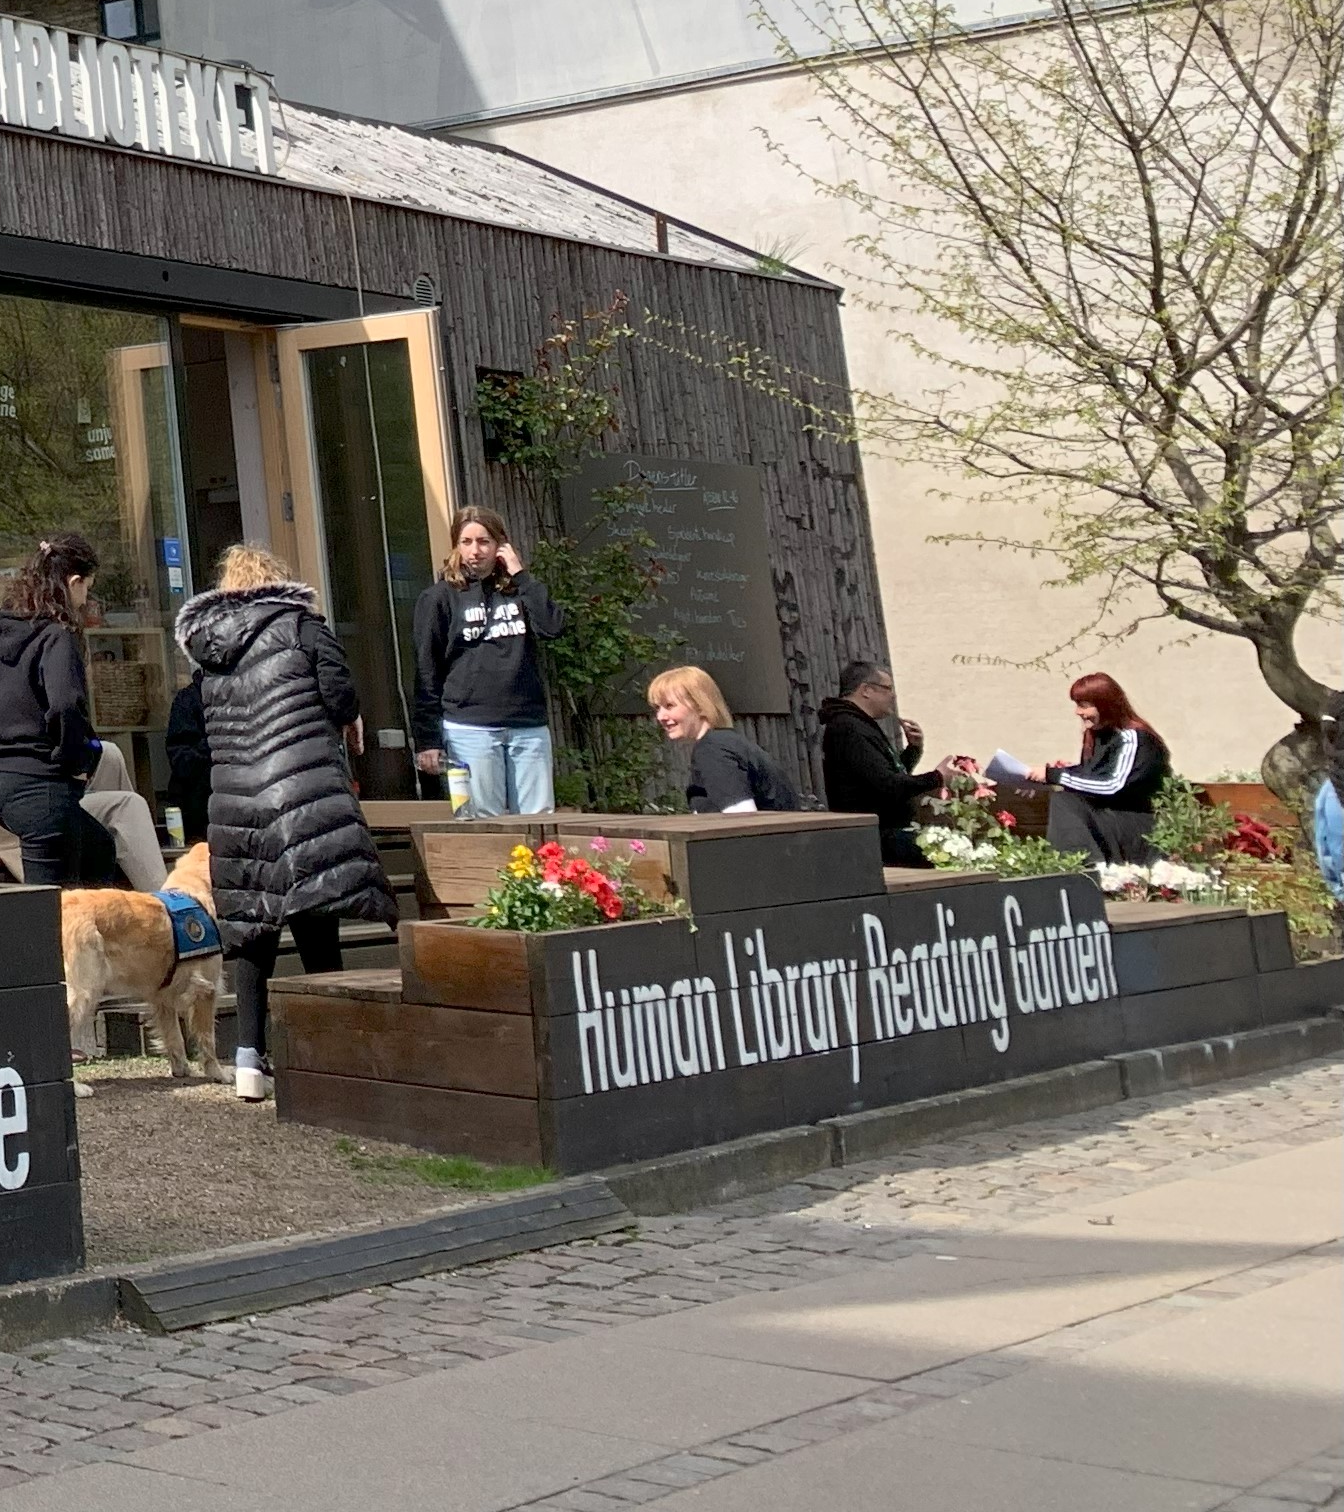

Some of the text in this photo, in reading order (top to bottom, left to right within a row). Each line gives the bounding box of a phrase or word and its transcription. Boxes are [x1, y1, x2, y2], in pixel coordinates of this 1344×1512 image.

[462, 620, 527, 642] soeone
[571, 888, 1119, 1095] Human Library Reading Garden
